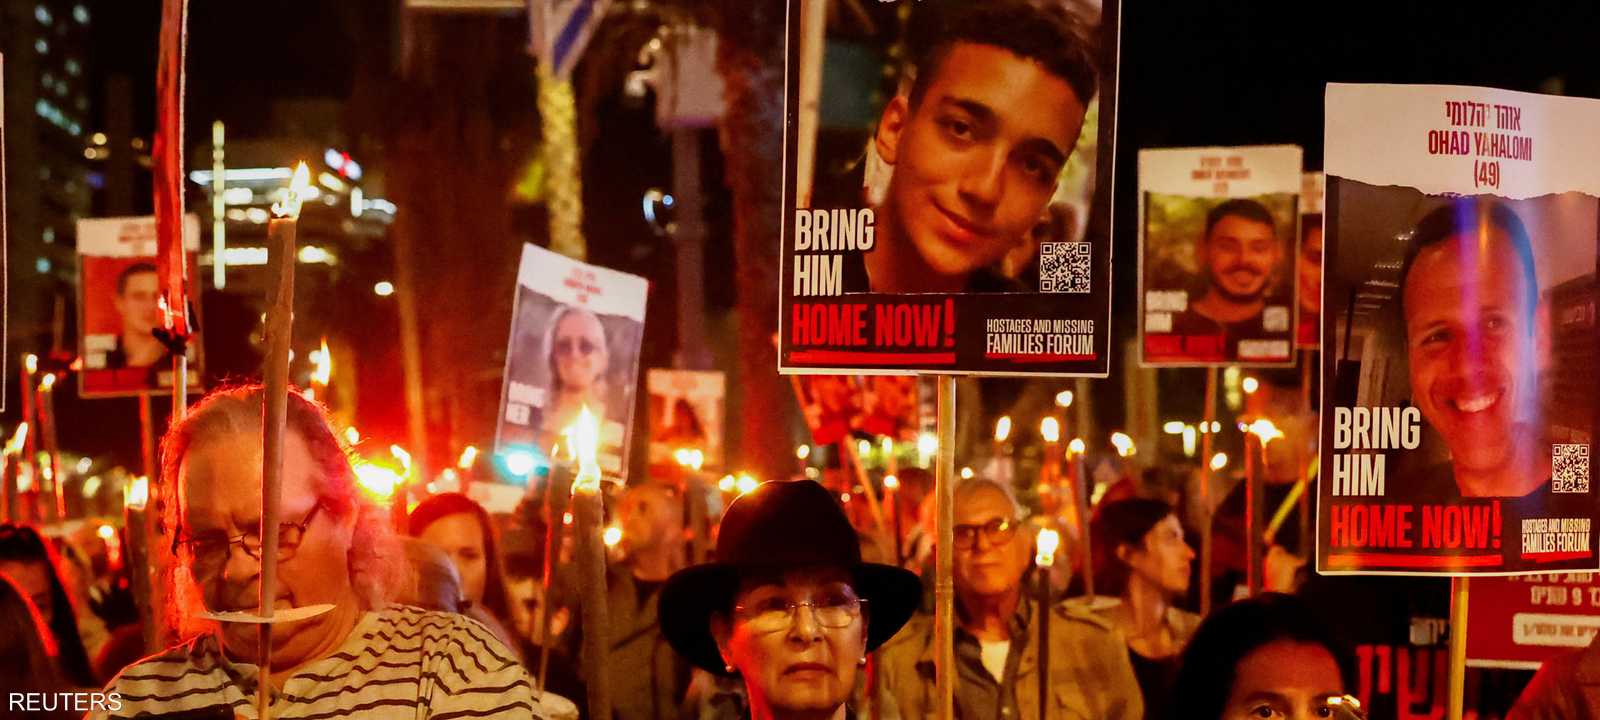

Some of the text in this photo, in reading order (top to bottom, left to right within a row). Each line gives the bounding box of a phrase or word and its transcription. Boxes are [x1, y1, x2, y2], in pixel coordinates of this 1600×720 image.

[1445, 100, 1521, 131] אוהד יהלומי
[1428, 130, 1532, 161] OHAD YAHALOMI
[1474, 160, 1500, 189] (49)
[794, 208, 875, 251] BRING
[793, 254, 843, 297] HIM
[792, 298, 956, 347] HOME NOW!
[986, 318, 1094, 334] HOSTAGES AND MISSING
[986, 333, 1094, 355] FAMILIES FORUM
[1333, 406, 1421, 450] BRING
[1332, 454, 1386, 497] HIM
[1330, 500, 1503, 549] HOME NOW!
[1522, 533, 1590, 554] FAMILIES FORUM
